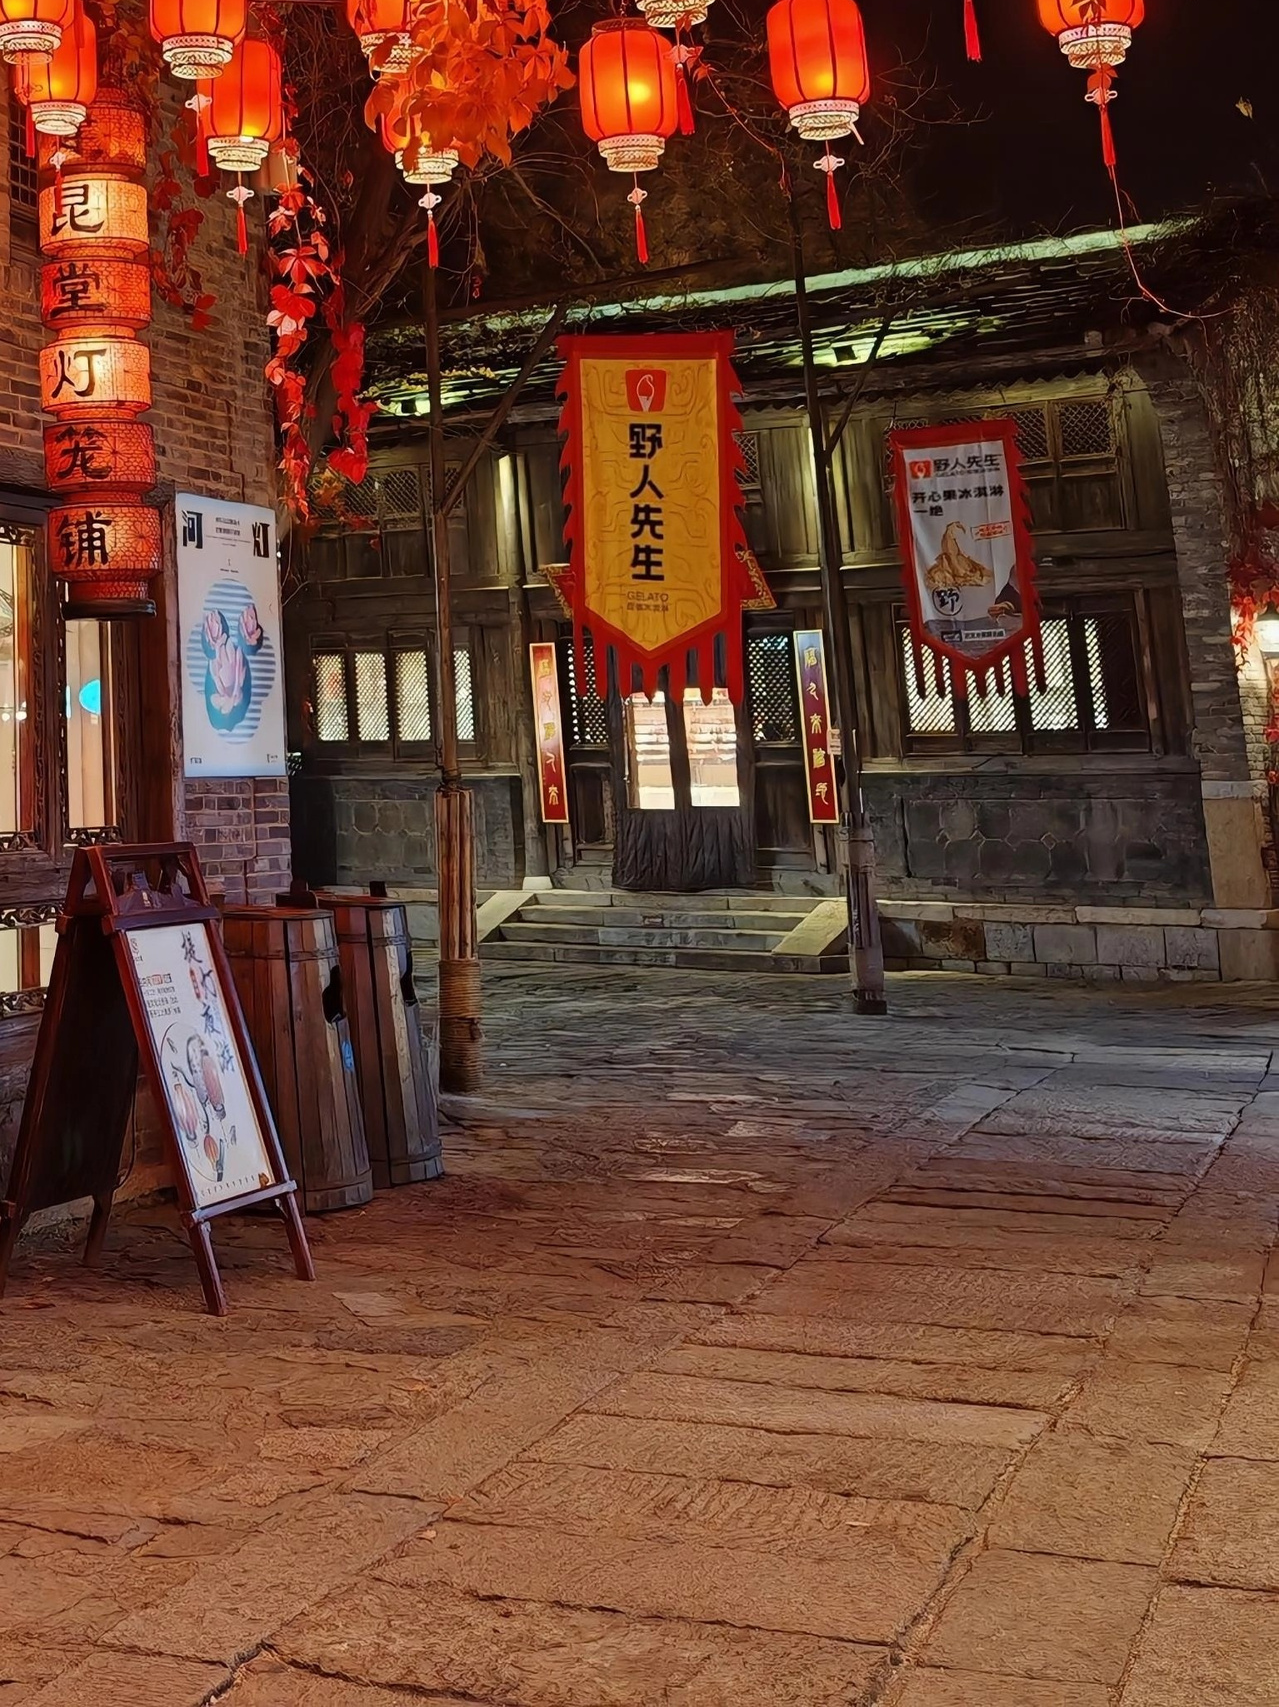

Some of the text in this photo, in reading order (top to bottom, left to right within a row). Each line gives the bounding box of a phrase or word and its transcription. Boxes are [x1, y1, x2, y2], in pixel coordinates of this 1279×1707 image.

[51, 118, 113, 568] 昆堂灯笼铺
[933, 454, 1003, 473] 野人先生
[628, 422, 665, 582] 野人先生
[911, 484, 1005, 504] 开心果冰淇淋
[627, 590, 669, 603] GELATO
